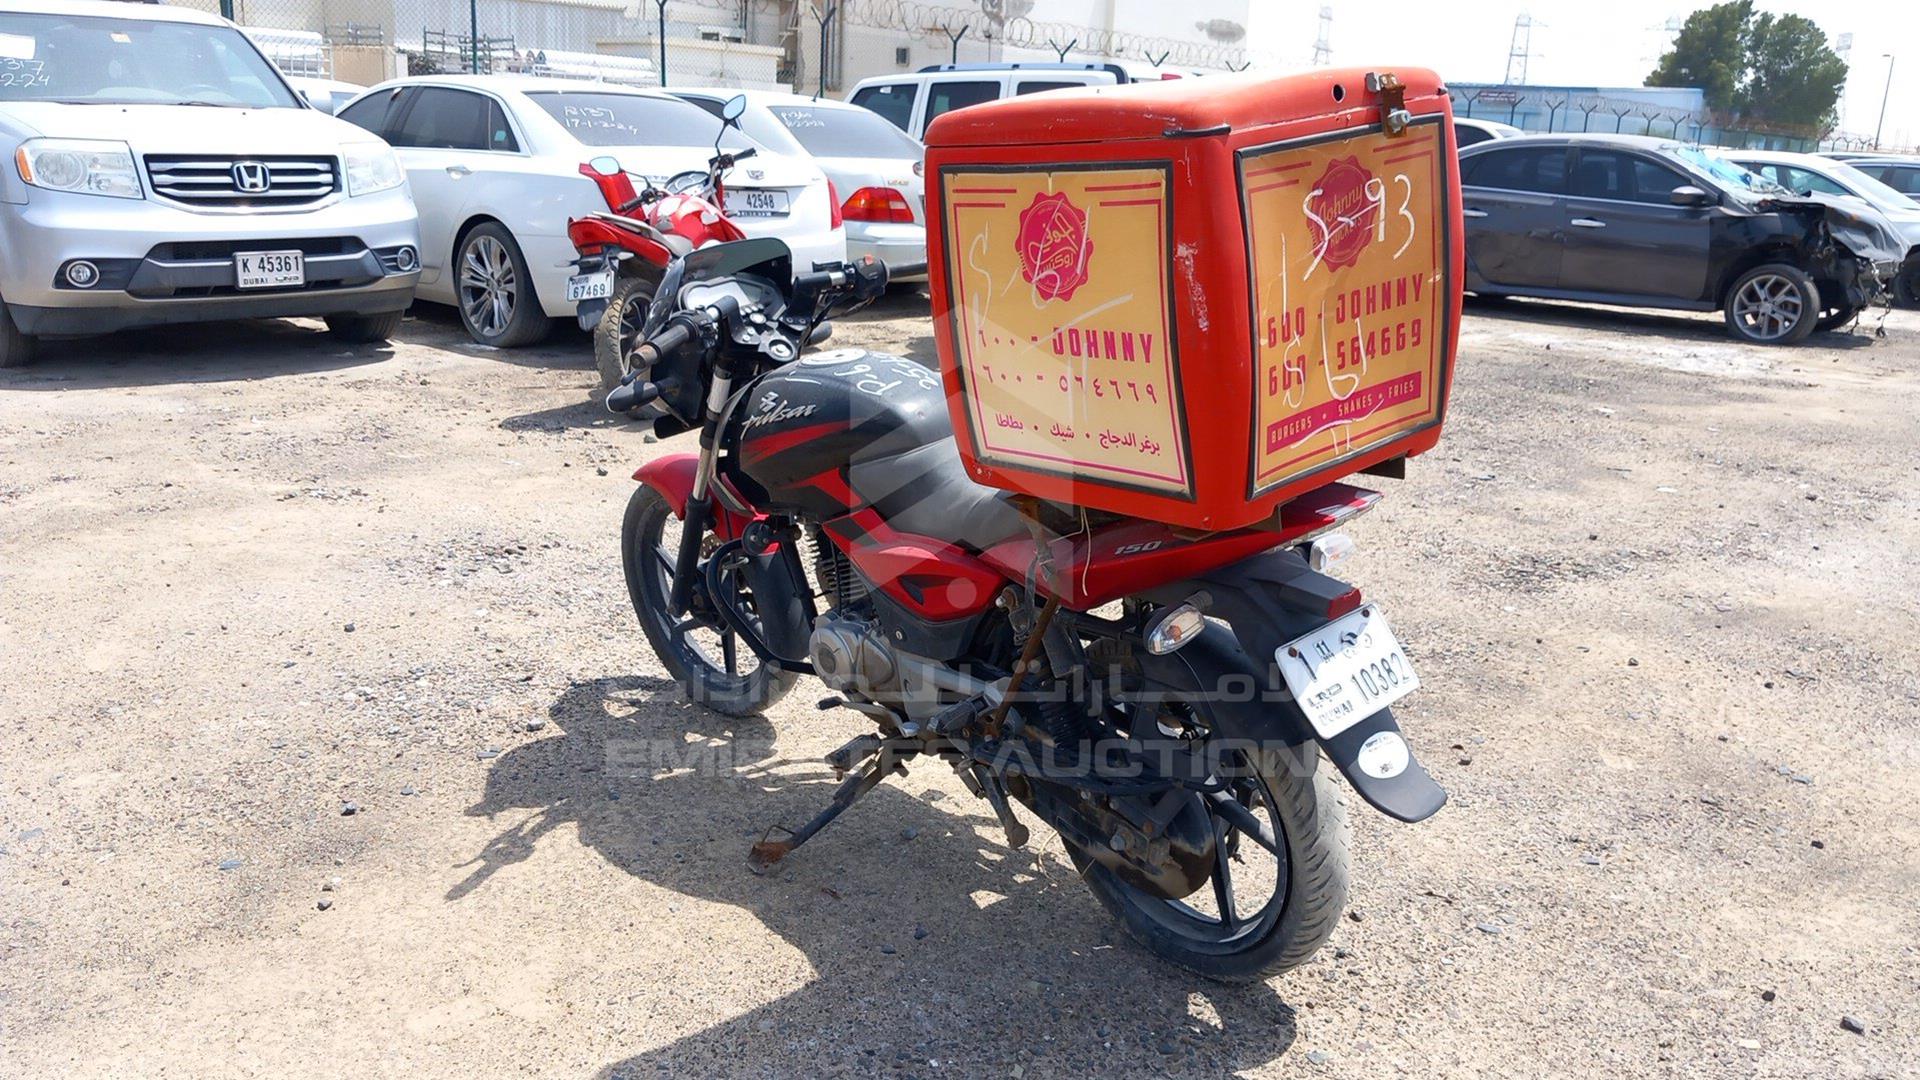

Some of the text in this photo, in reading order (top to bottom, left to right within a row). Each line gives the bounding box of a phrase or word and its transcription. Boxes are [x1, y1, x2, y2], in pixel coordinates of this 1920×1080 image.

[746, 192, 775, 209] 42548
[241, 255, 300, 274] K 45361
[573, 283, 606, 299] 67469
[1267, 306, 1305, 349] 600
[1335, 272, 1424, 325] JOHNNY
[1051, 326, 1153, 364] JOHNNY
[1269, 354, 1306, 397] 600
[1336, 318, 1422, 371] 564669
[1271, 379, 1415, 444] BURGERS SHAKES FRIES
[1114, 540, 1162, 555] 150
[1351, 651, 1410, 704] 10382
